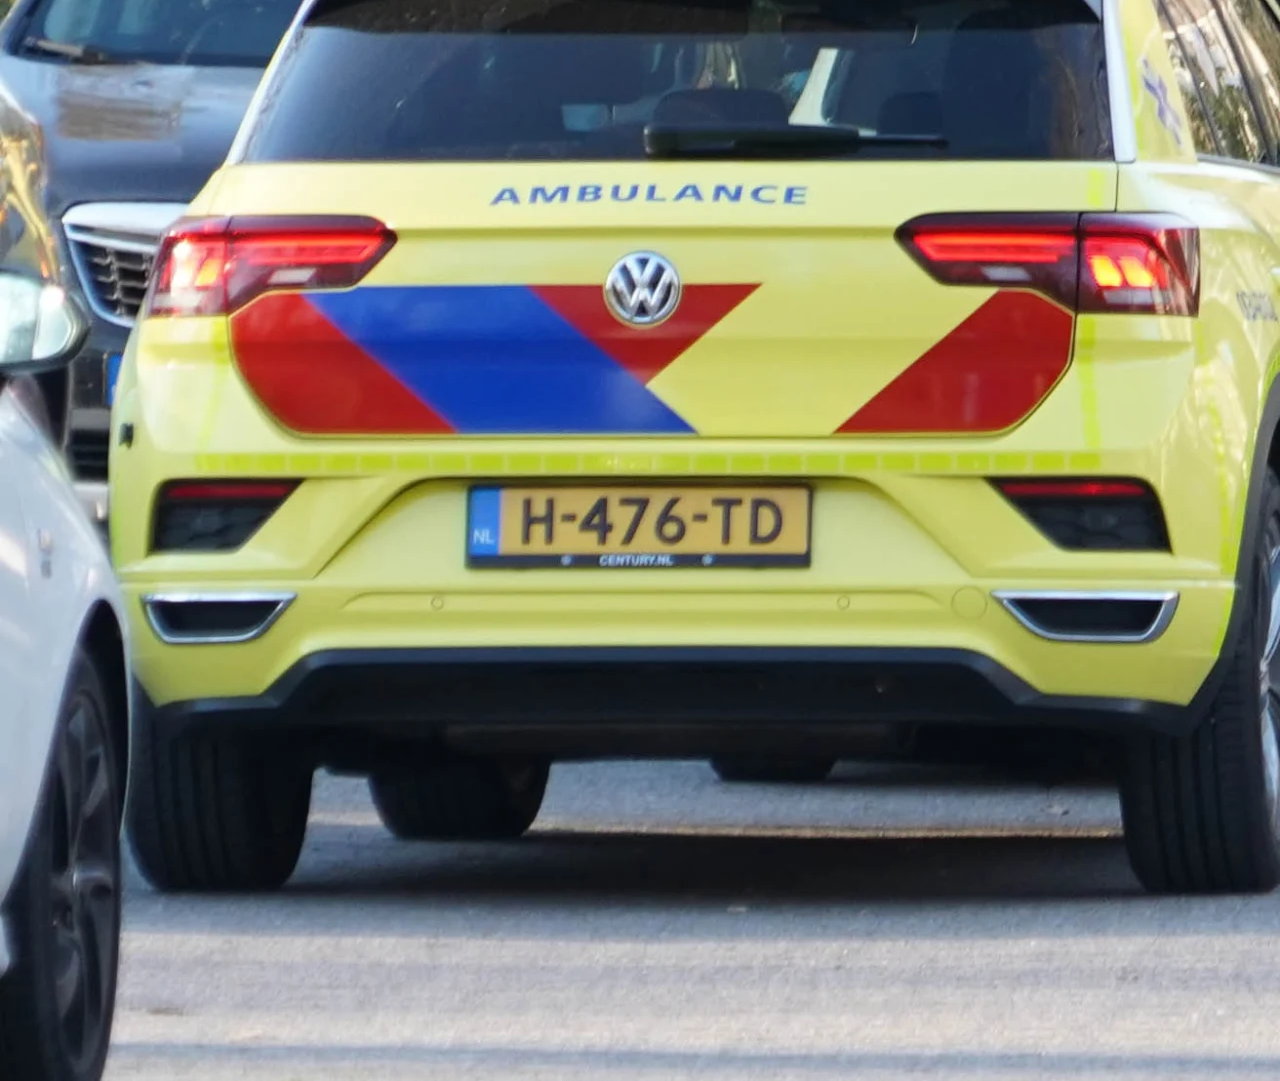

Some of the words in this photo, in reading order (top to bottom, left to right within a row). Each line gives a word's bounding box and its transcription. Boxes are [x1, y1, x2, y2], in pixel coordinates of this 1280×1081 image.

[490, 184, 807, 206] AMBULANCE
[521, 496, 783, 546] H-476-TD
[473, 528, 495, 545] NL
